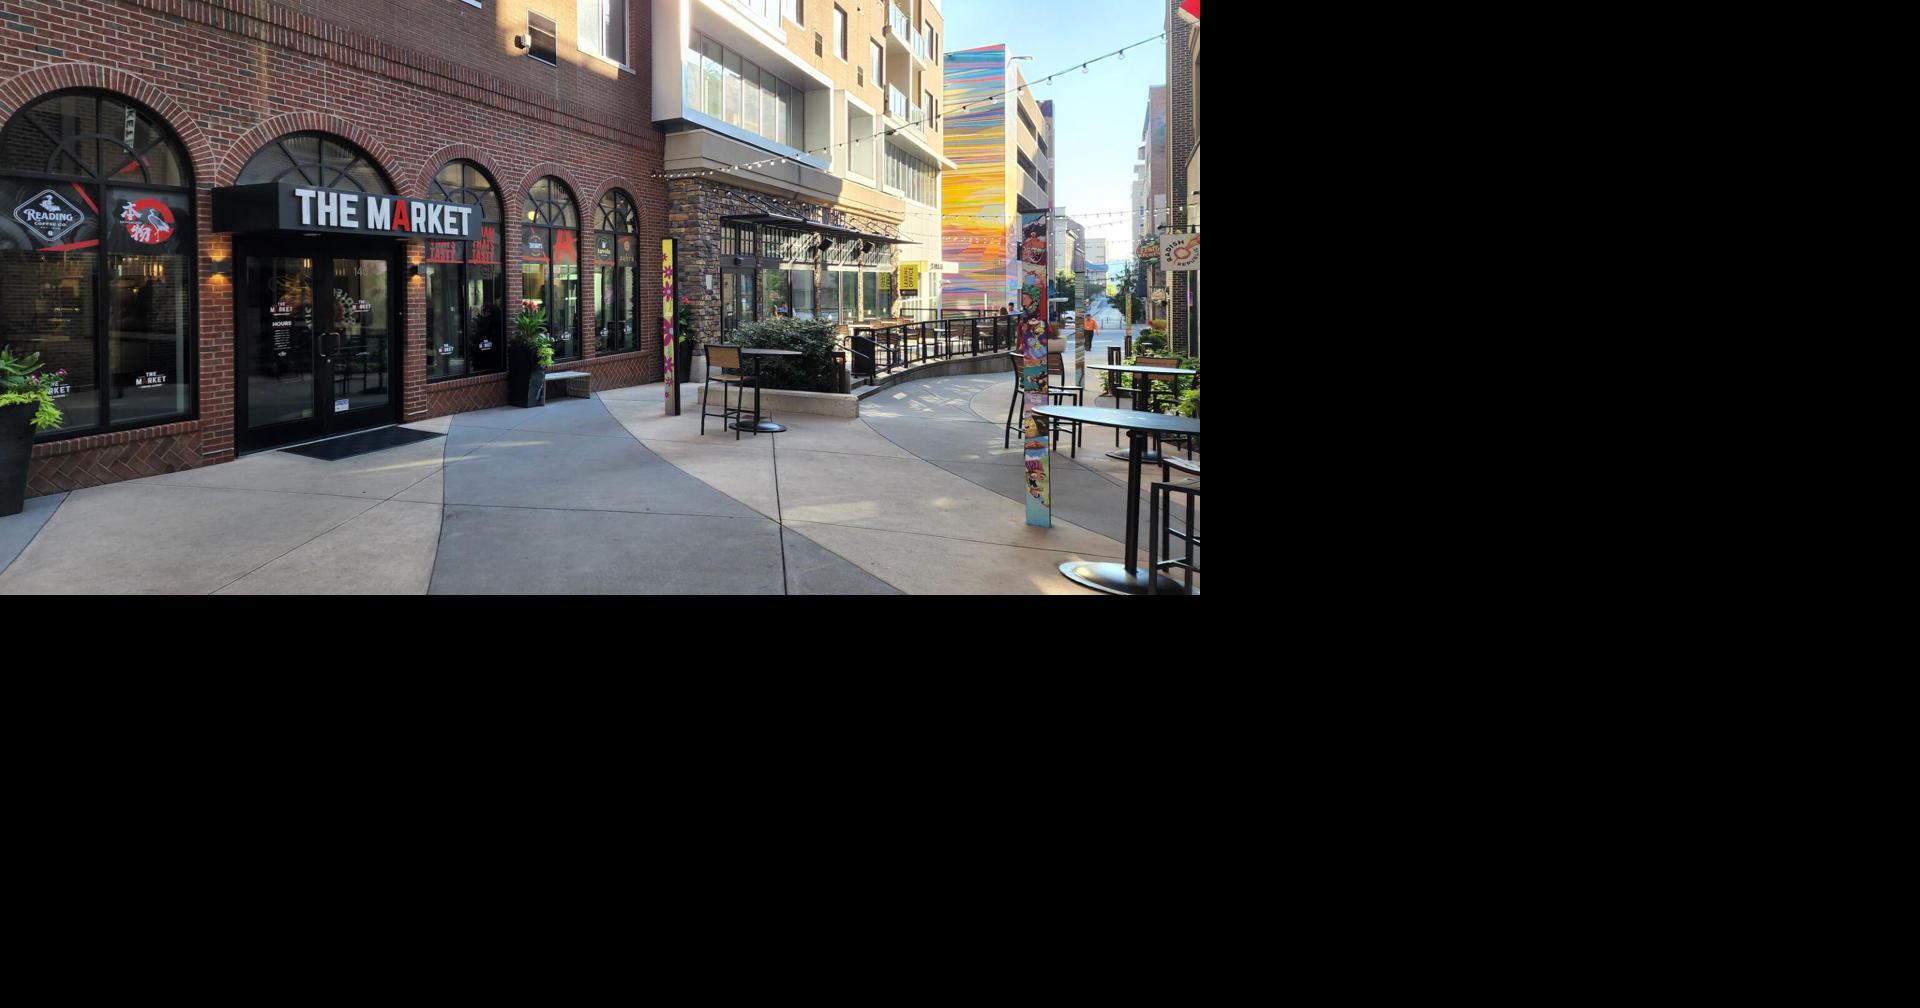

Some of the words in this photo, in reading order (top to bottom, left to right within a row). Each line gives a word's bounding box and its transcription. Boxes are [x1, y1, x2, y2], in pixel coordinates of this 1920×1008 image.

[23, 208, 73, 222] READING
[295, 188, 359, 228] THE
[367, 196, 472, 236] MARKET
[1165, 240, 1184, 263] RADISH
[136, 375, 166, 386] MARKET
[50, 385, 71, 395] RKET
